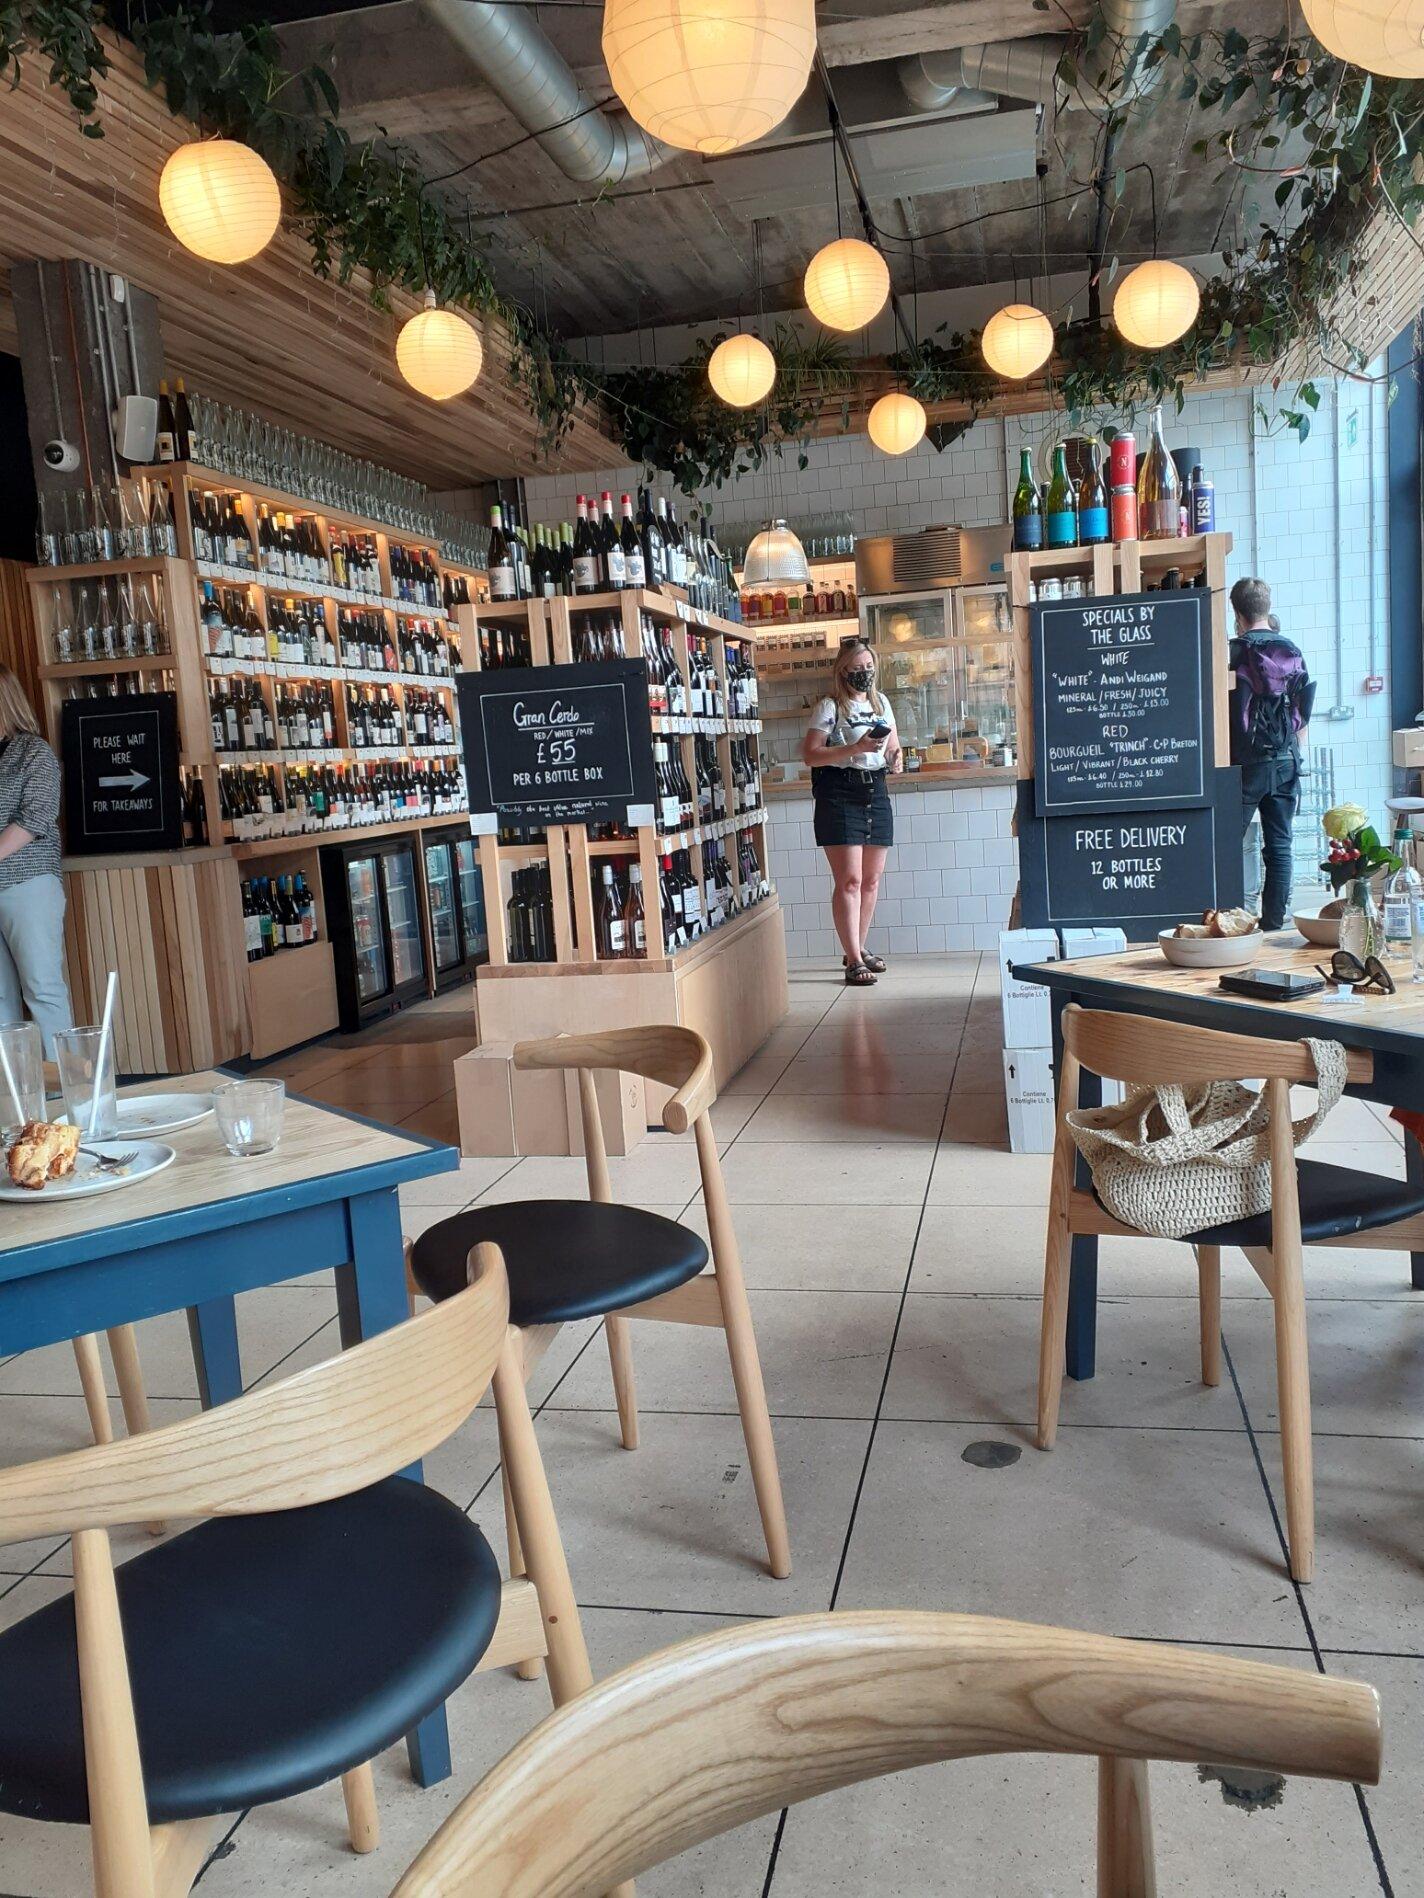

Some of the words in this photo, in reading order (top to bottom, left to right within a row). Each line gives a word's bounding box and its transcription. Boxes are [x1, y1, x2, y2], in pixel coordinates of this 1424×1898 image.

[1197, 496, 1211, 526] YES!
[1082, 607, 1135, 627] SPECIALS
[1139, 605, 1156, 621] BY
[1090, 628, 1113, 644] THE
[1118, 625, 1152, 642] GLASS
[1100, 651, 1130, 666] WHITE
[1058, 692, 1097, 703] MINERAL
[513, 702, 546, 727] Gran
[549, 700, 580, 725] Cerdo
[554, 729, 574, 738] WHITE
[1102, 725, 1129, 739] RED
[93, 735, 121, 749] PLEASE
[127, 733, 146, 746] WAIT
[111, 751, 131, 765] HERE
[1049, 744, 1105, 760] BOURGUEIL
[513, 772, 532, 786] PER
[534, 771, 542, 785] 6
[545, 768, 580, 784] BOTTLE
[584, 766, 604, 780] BOX
[93, 800, 109, 813] FOR
[111, 798, 153, 812] TAKEAWAYS
[1075, 828, 1114, 851] FREE
[1120, 825, 1187, 848] DELIVERY
[1091, 860, 1104, 875] 12
[1111, 857, 1163, 874] BOTTLES
[1102, 876, 1119, 890] OR
[1124, 874, 1156, 889] MORE
